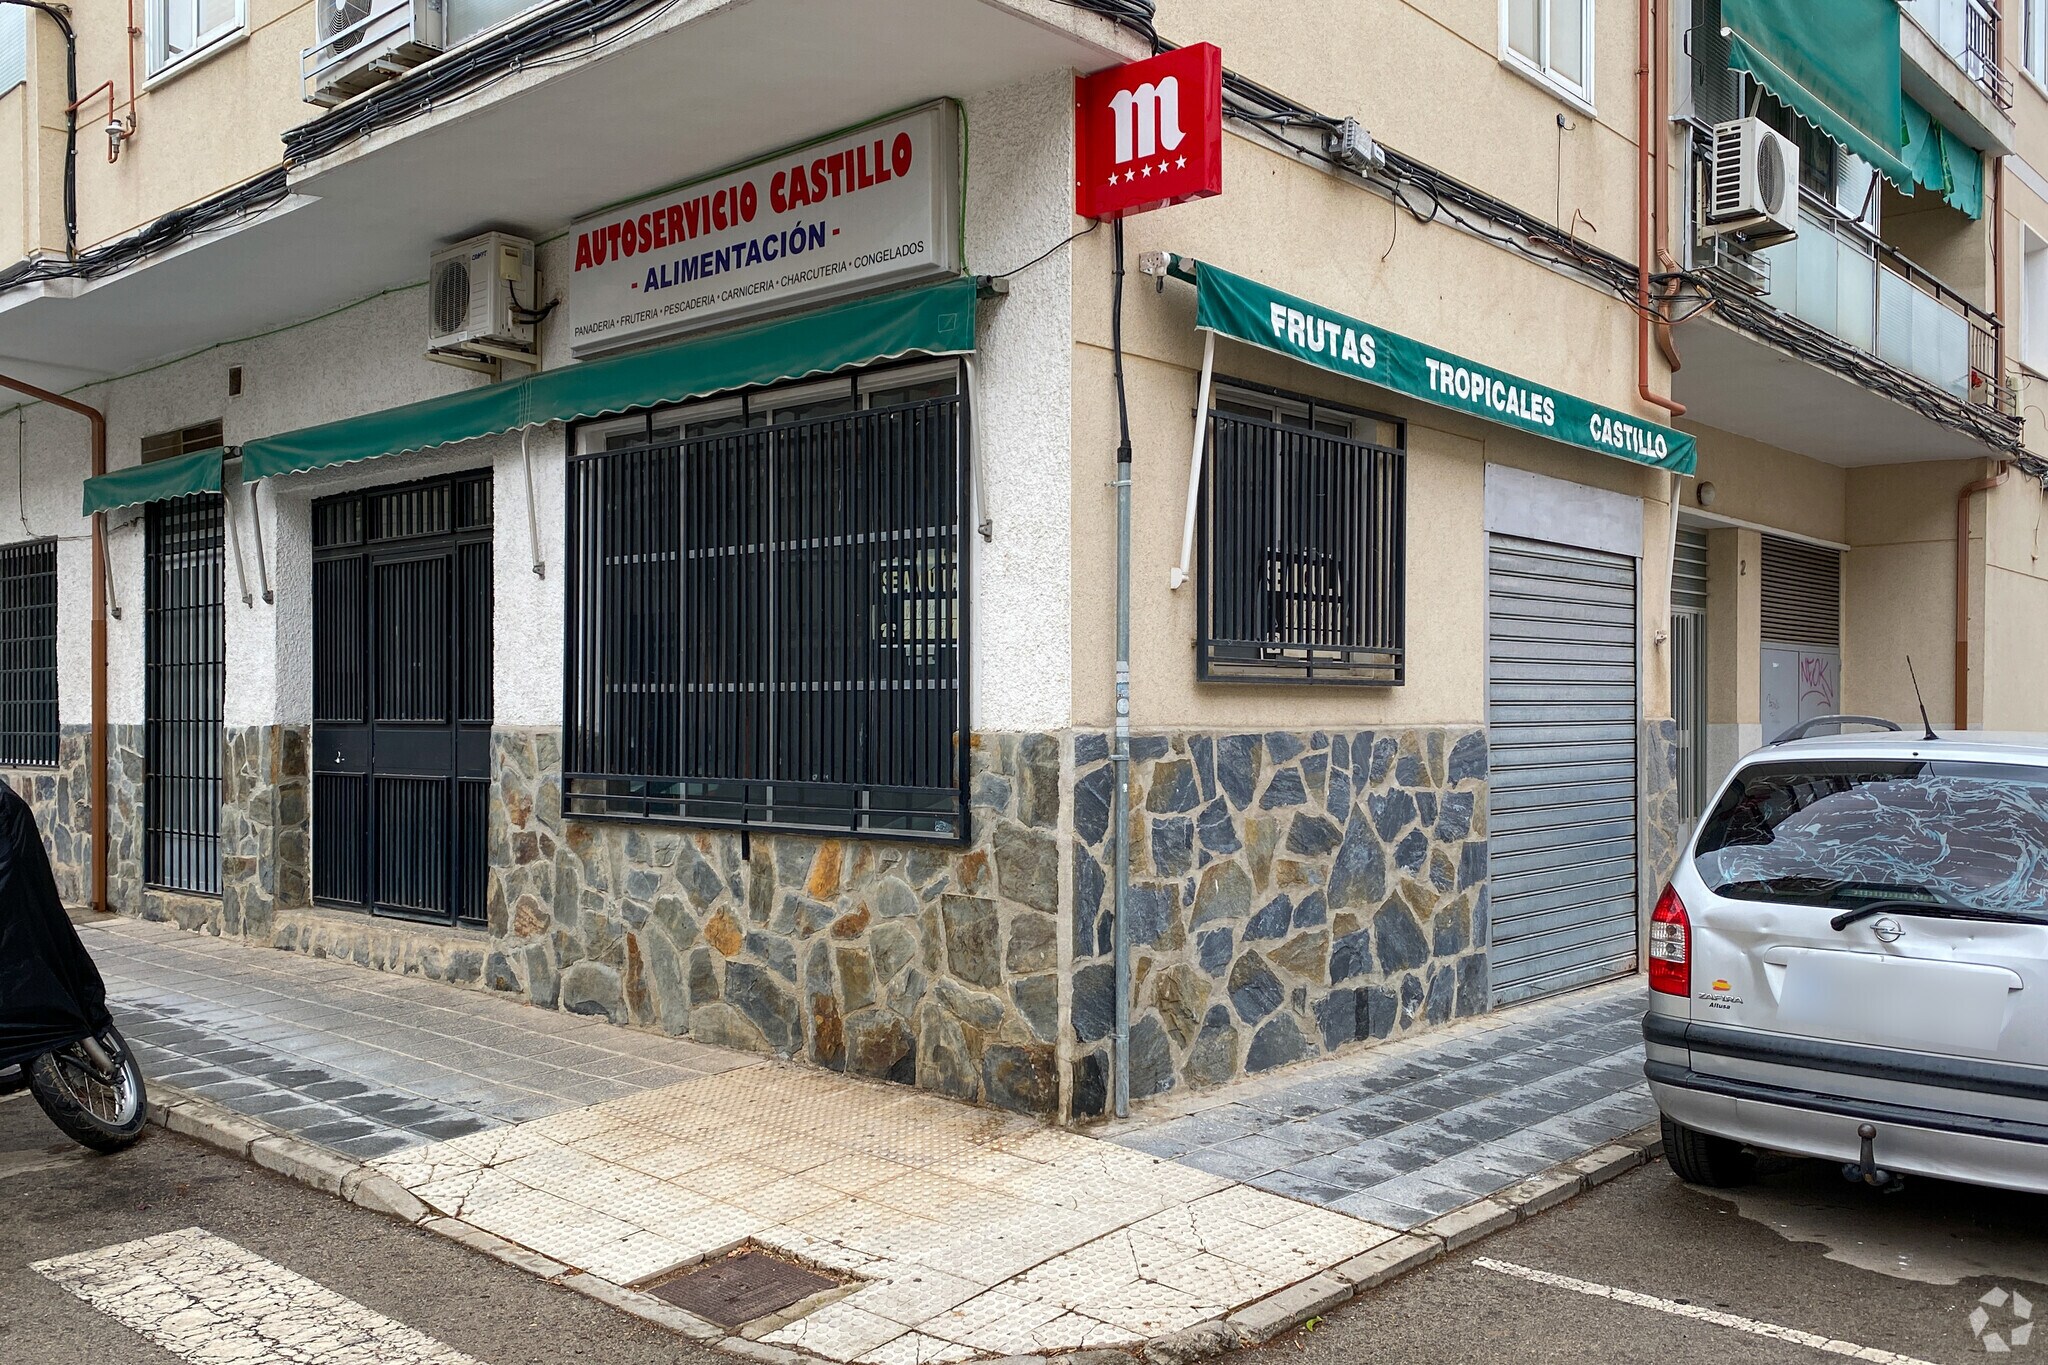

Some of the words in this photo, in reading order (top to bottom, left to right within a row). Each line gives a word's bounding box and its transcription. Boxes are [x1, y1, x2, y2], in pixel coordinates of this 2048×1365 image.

[573, 181, 759, 273] AUTOSERVICIO
[769, 132, 913, 214] CASTILLO
[574, 318, 616, 338] PANADERIA
[620, 307, 659, 327] FRUTERIA
[663, 293, 716, 317] PESCADERIA
[721, 279, 775, 303] CARNICERIA
[780, 260, 847, 288] CHARCUTERIA
[853, 240, 924, 269] CONGELADOS
[644, 221, 827, 294] ALIMENTACIÓN
[1270, 302, 1376, 369] FRUTAS
[1425, 357, 1555, 427] TROPICALES
[1589, 413, 1668, 460] CASTILLO
[1740, 559, 1747, 576] 2
[1699, 992, 1743, 1004] ZAFIRA
